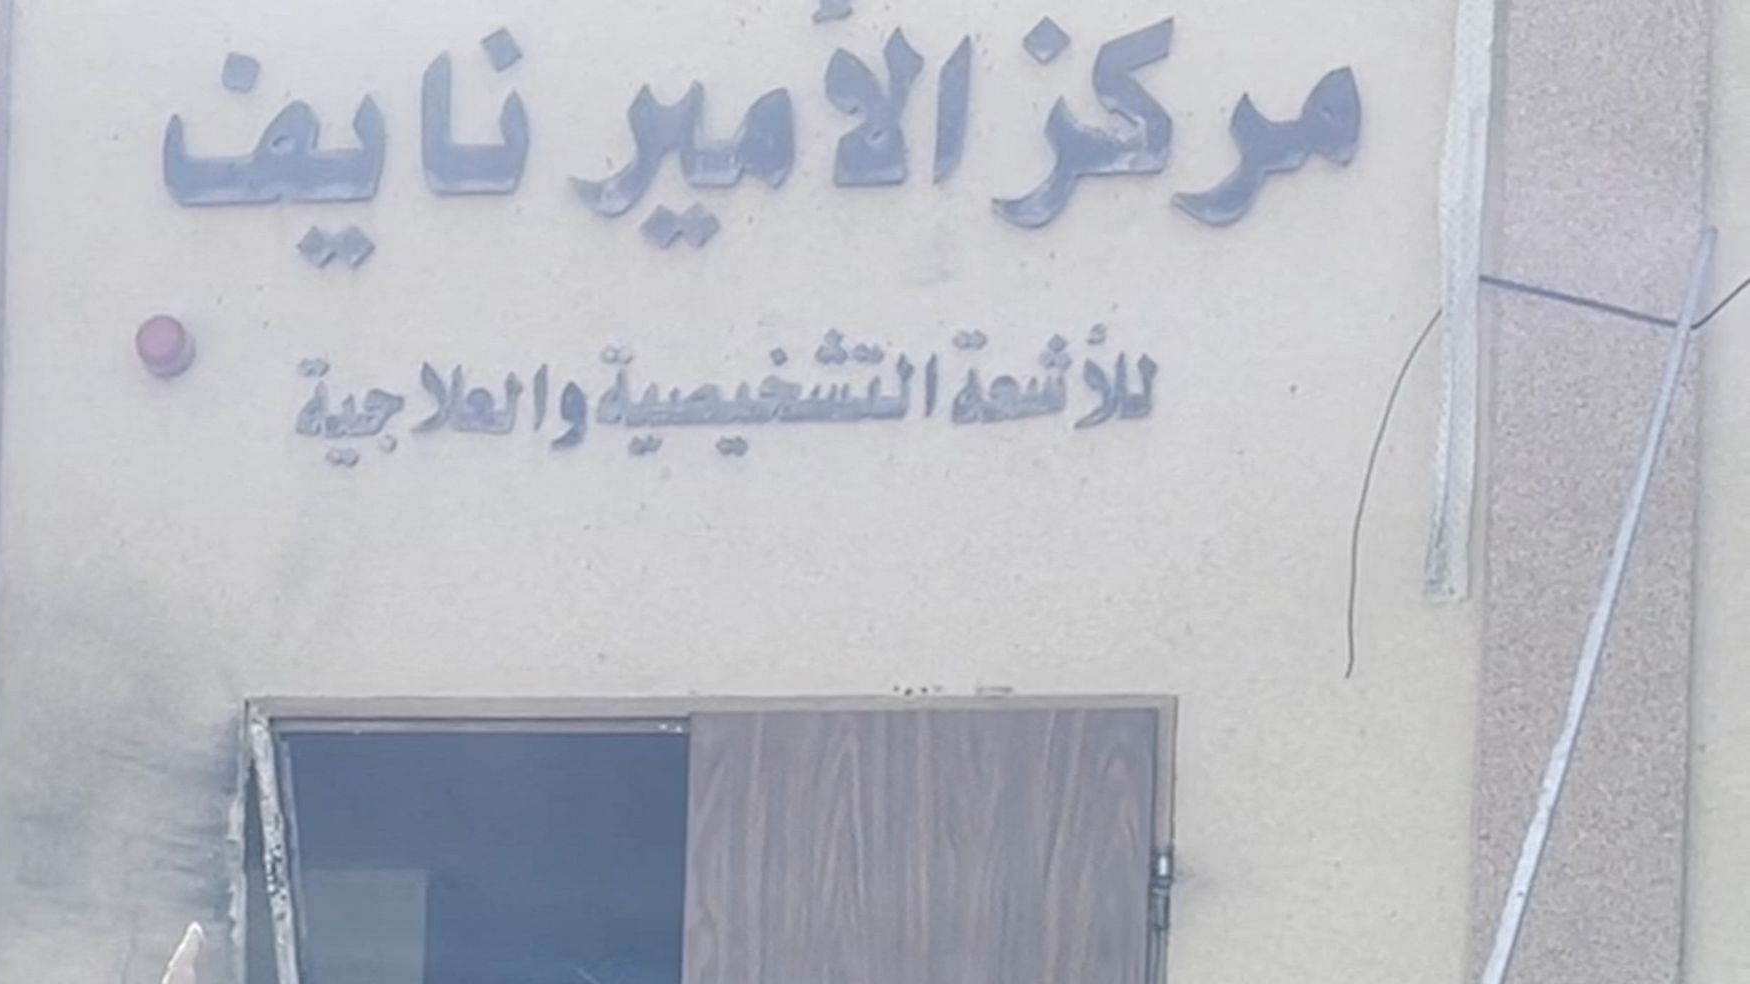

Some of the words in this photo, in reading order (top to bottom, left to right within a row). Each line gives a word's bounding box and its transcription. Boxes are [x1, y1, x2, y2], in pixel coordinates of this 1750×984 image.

[162, 26, 531, 268] نايف
[991, 16, 1362, 228] مركز
[294, 357, 589, 467] والعلاجية
[595, 328, 938, 457] التشخيصية
[951, 323, 1158, 430] للأشعة
